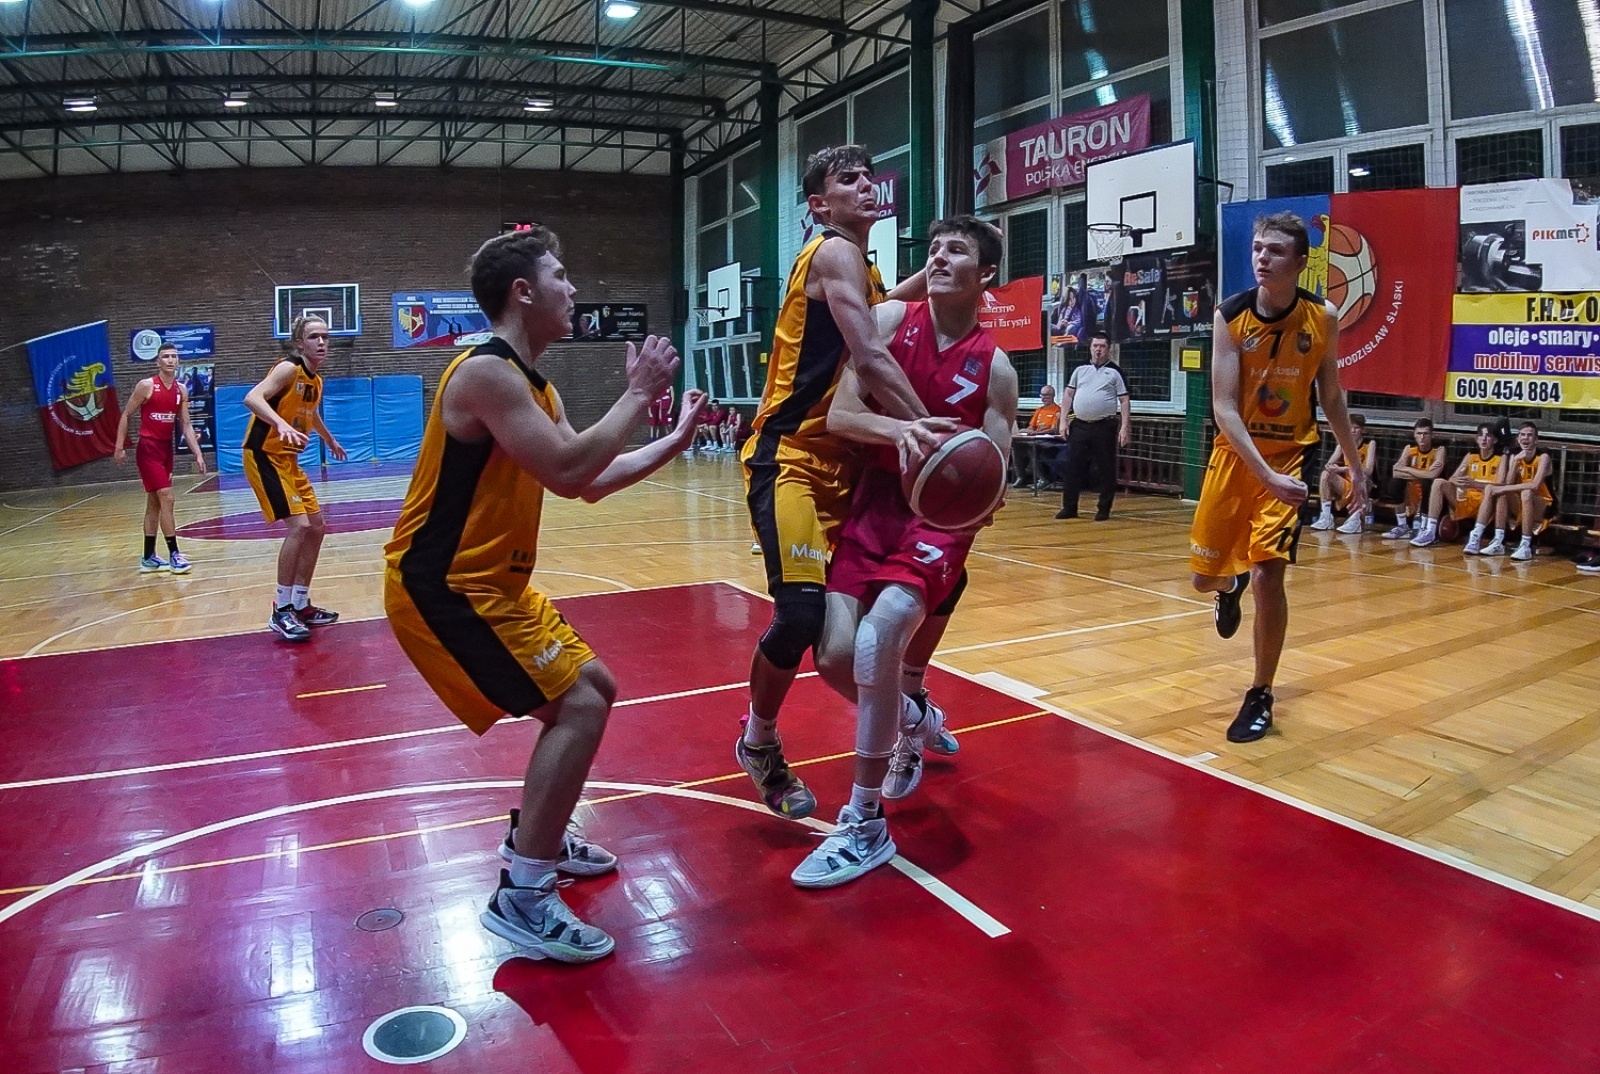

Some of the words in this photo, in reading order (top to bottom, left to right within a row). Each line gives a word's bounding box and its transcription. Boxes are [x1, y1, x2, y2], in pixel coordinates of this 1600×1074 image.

[1020, 112, 1130, 168] TAURON
[1533, 228, 1581, 240] PIKMET
[1337, 325, 1389, 368] WODZISŁAW
[1474, 352, 1540, 373] mobilny
[1546, 354, 1600, 372] serwis
[945, 373, 979, 404] 7
[1456, 378, 1488, 398] 609
[1491, 380, 1523, 401] 454
[1528, 382, 1561, 402] 884
[913, 541, 943, 564] 7
